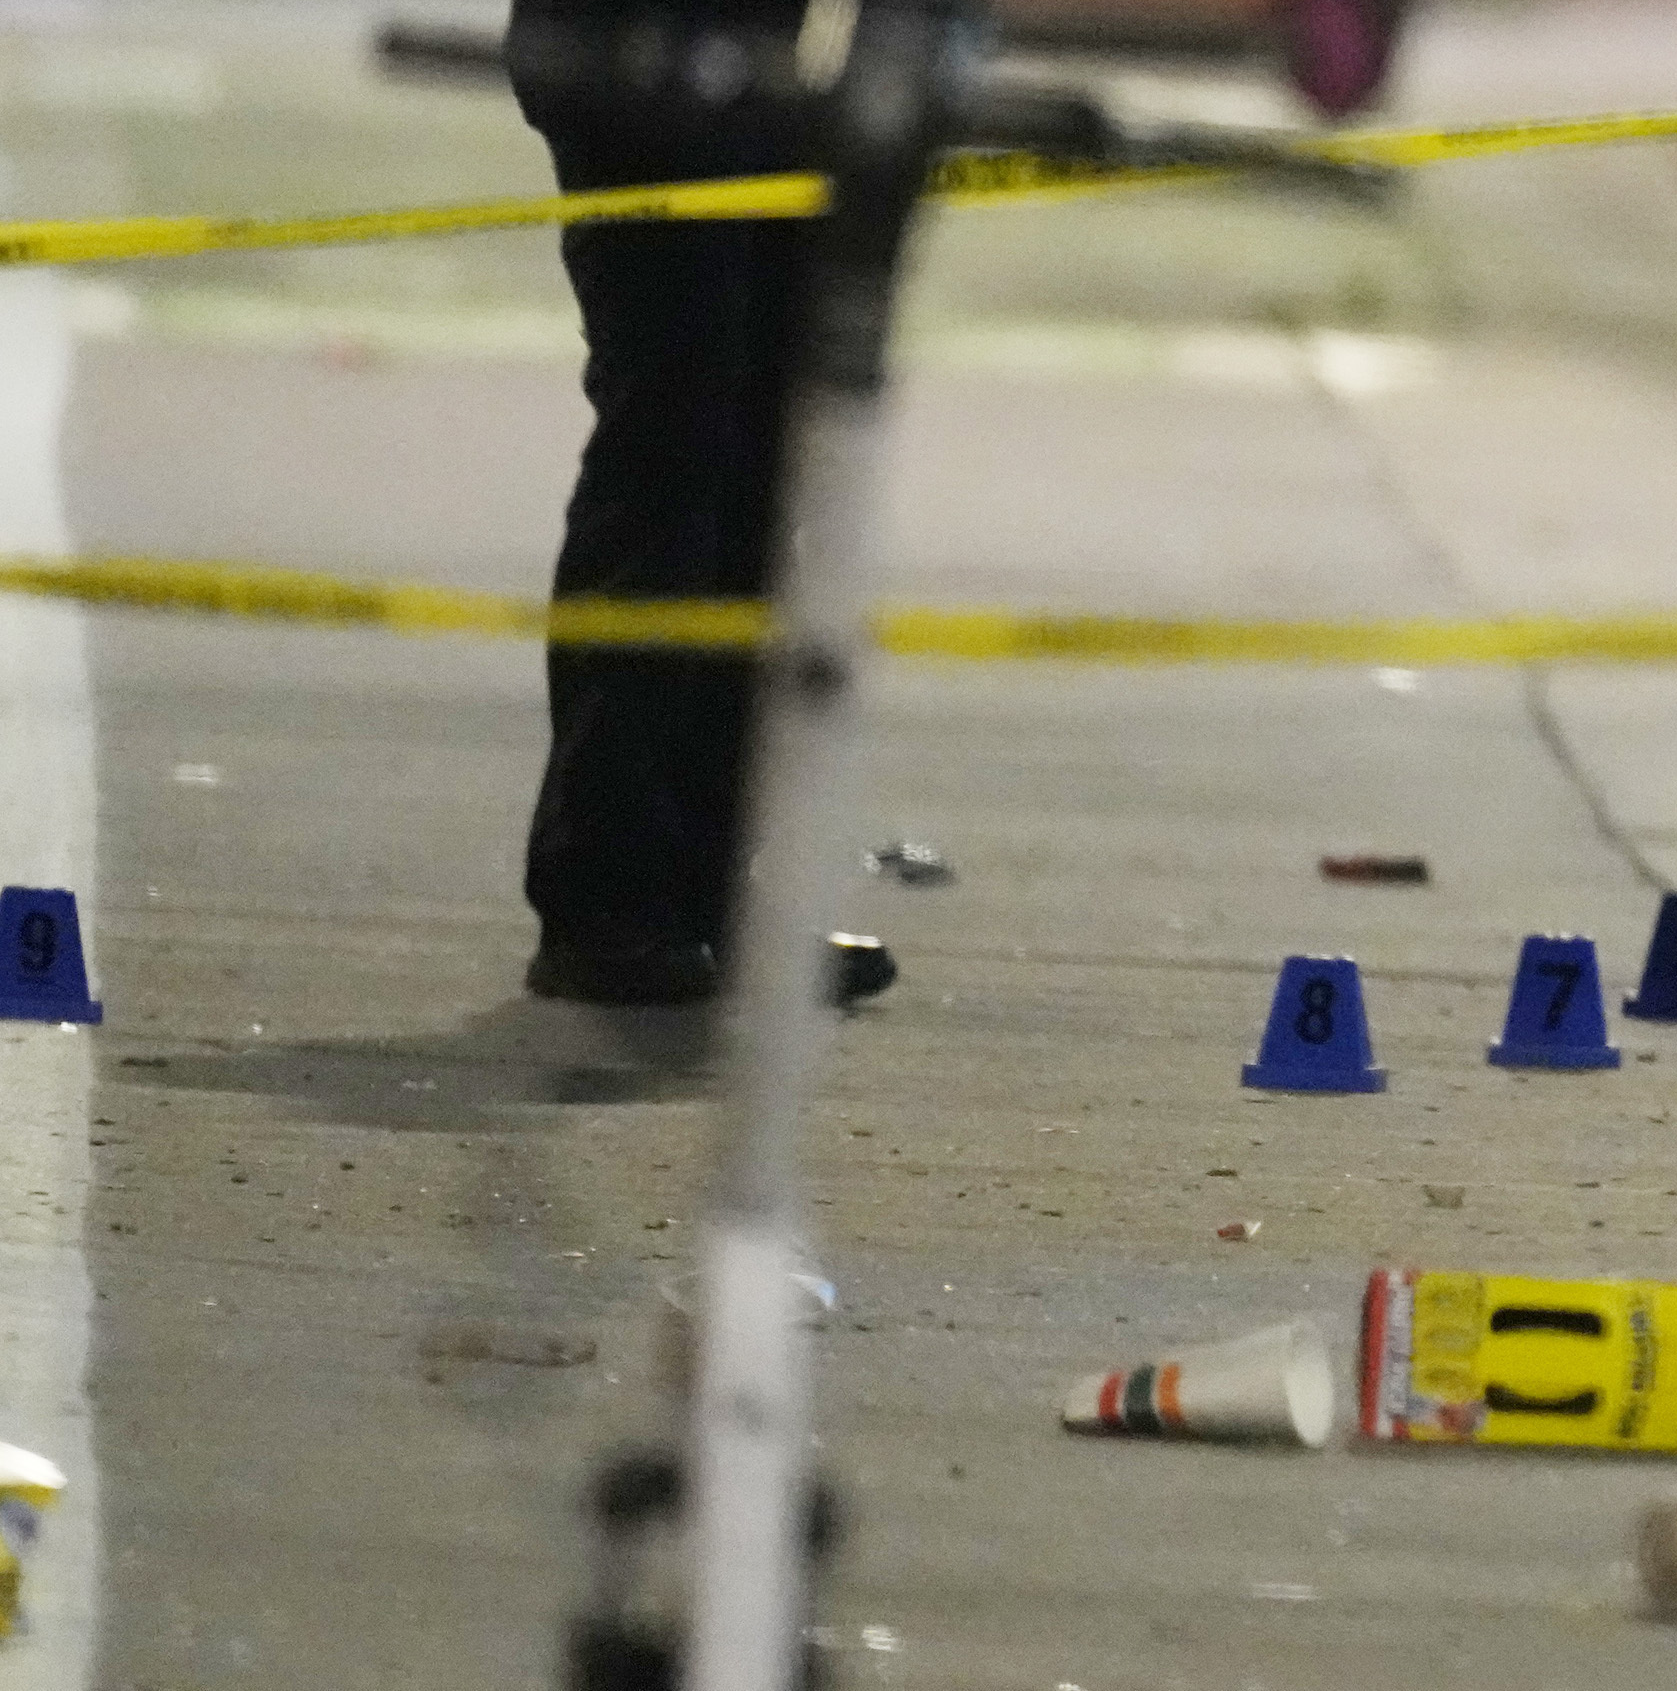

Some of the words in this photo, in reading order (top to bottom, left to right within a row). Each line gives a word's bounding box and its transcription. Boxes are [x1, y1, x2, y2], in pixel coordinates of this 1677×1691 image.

[20, 912, 58, 978] 9
[1299, 977, 1336, 1044] 8
[1536, 963, 1582, 1030] 7
